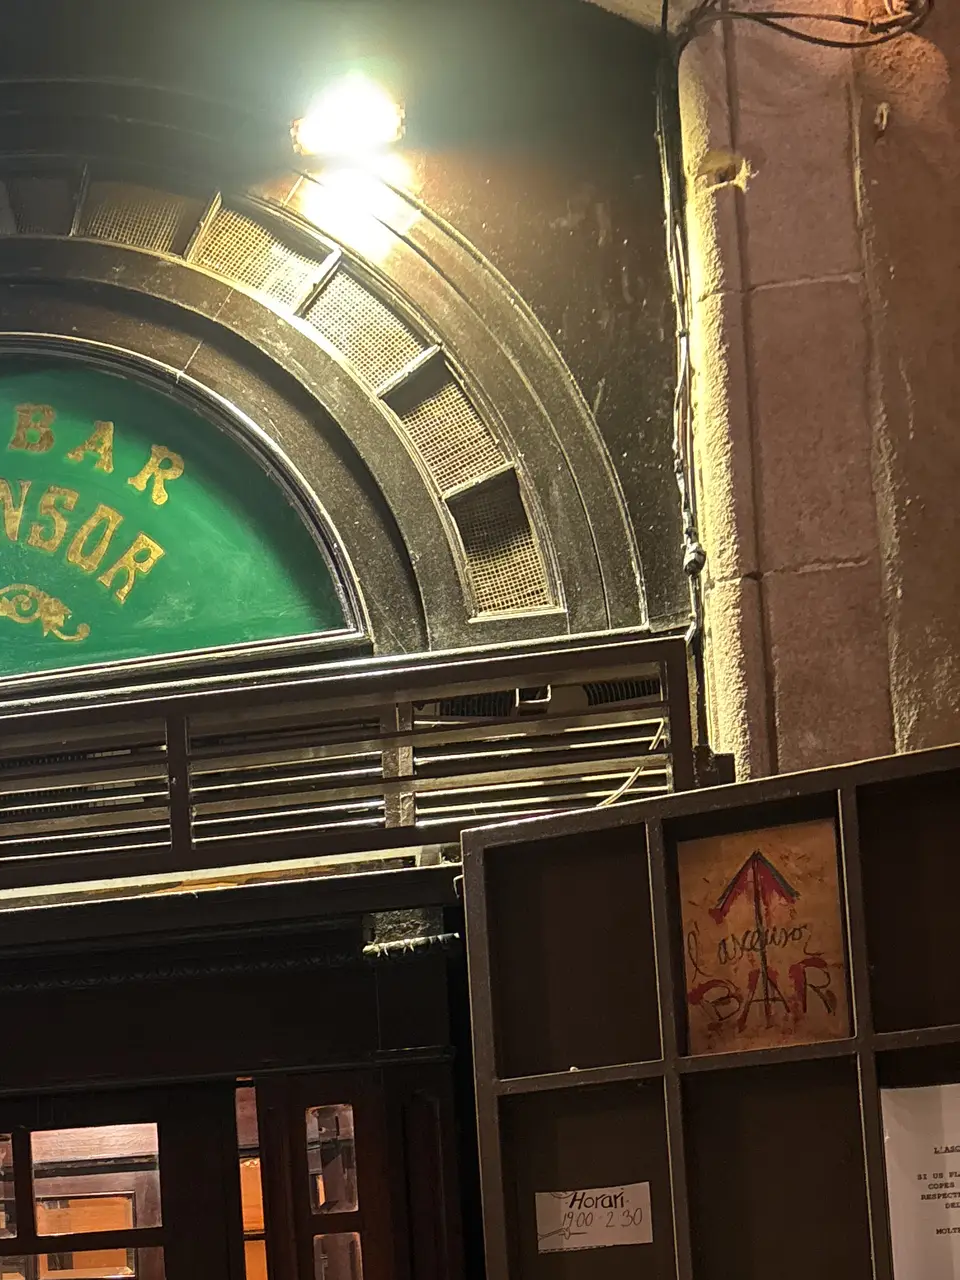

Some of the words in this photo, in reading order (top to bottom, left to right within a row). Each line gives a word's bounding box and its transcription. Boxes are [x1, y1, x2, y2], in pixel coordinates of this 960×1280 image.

[7, 403, 185, 505] BAR
[688, 957, 837, 1033] BAR
[569, 1188, 625, 1210] Horari
